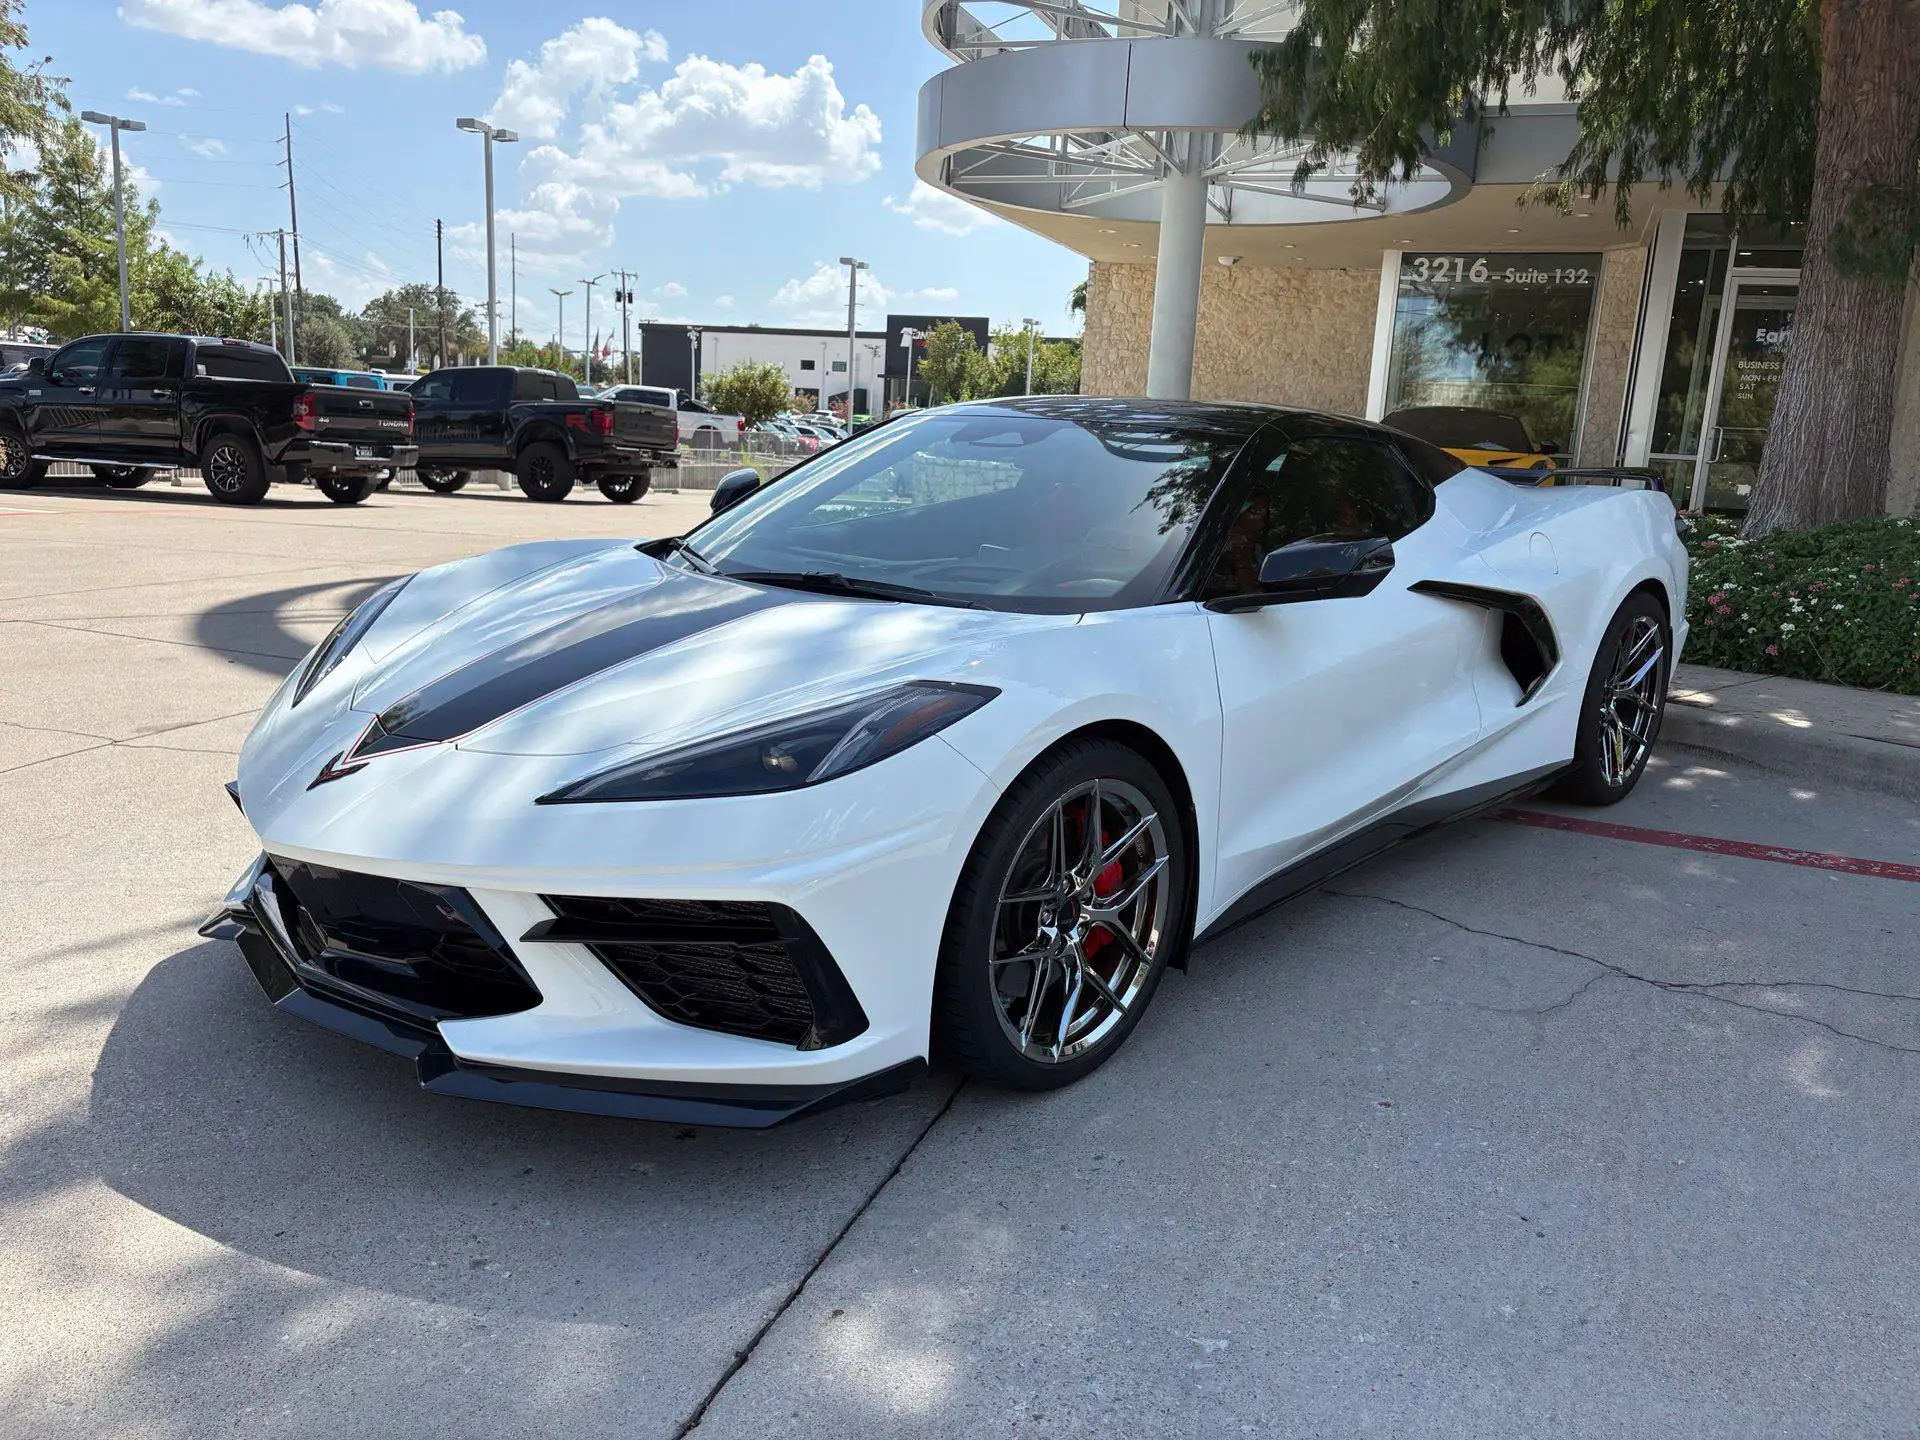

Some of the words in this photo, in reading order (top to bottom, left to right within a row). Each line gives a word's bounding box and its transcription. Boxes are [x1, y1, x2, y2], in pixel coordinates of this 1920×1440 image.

[1413, 257, 1489, 283] 3216
[1505, 267, 1549, 284] Suite
[1554, 268, 1589, 284] 132
[1738, 360, 1780, 370] BUSINESS
[1740, 374, 1761, 382] MON
[1737, 392, 1754, 400] SUN
[378, 420, 409, 428] TUNDRA
